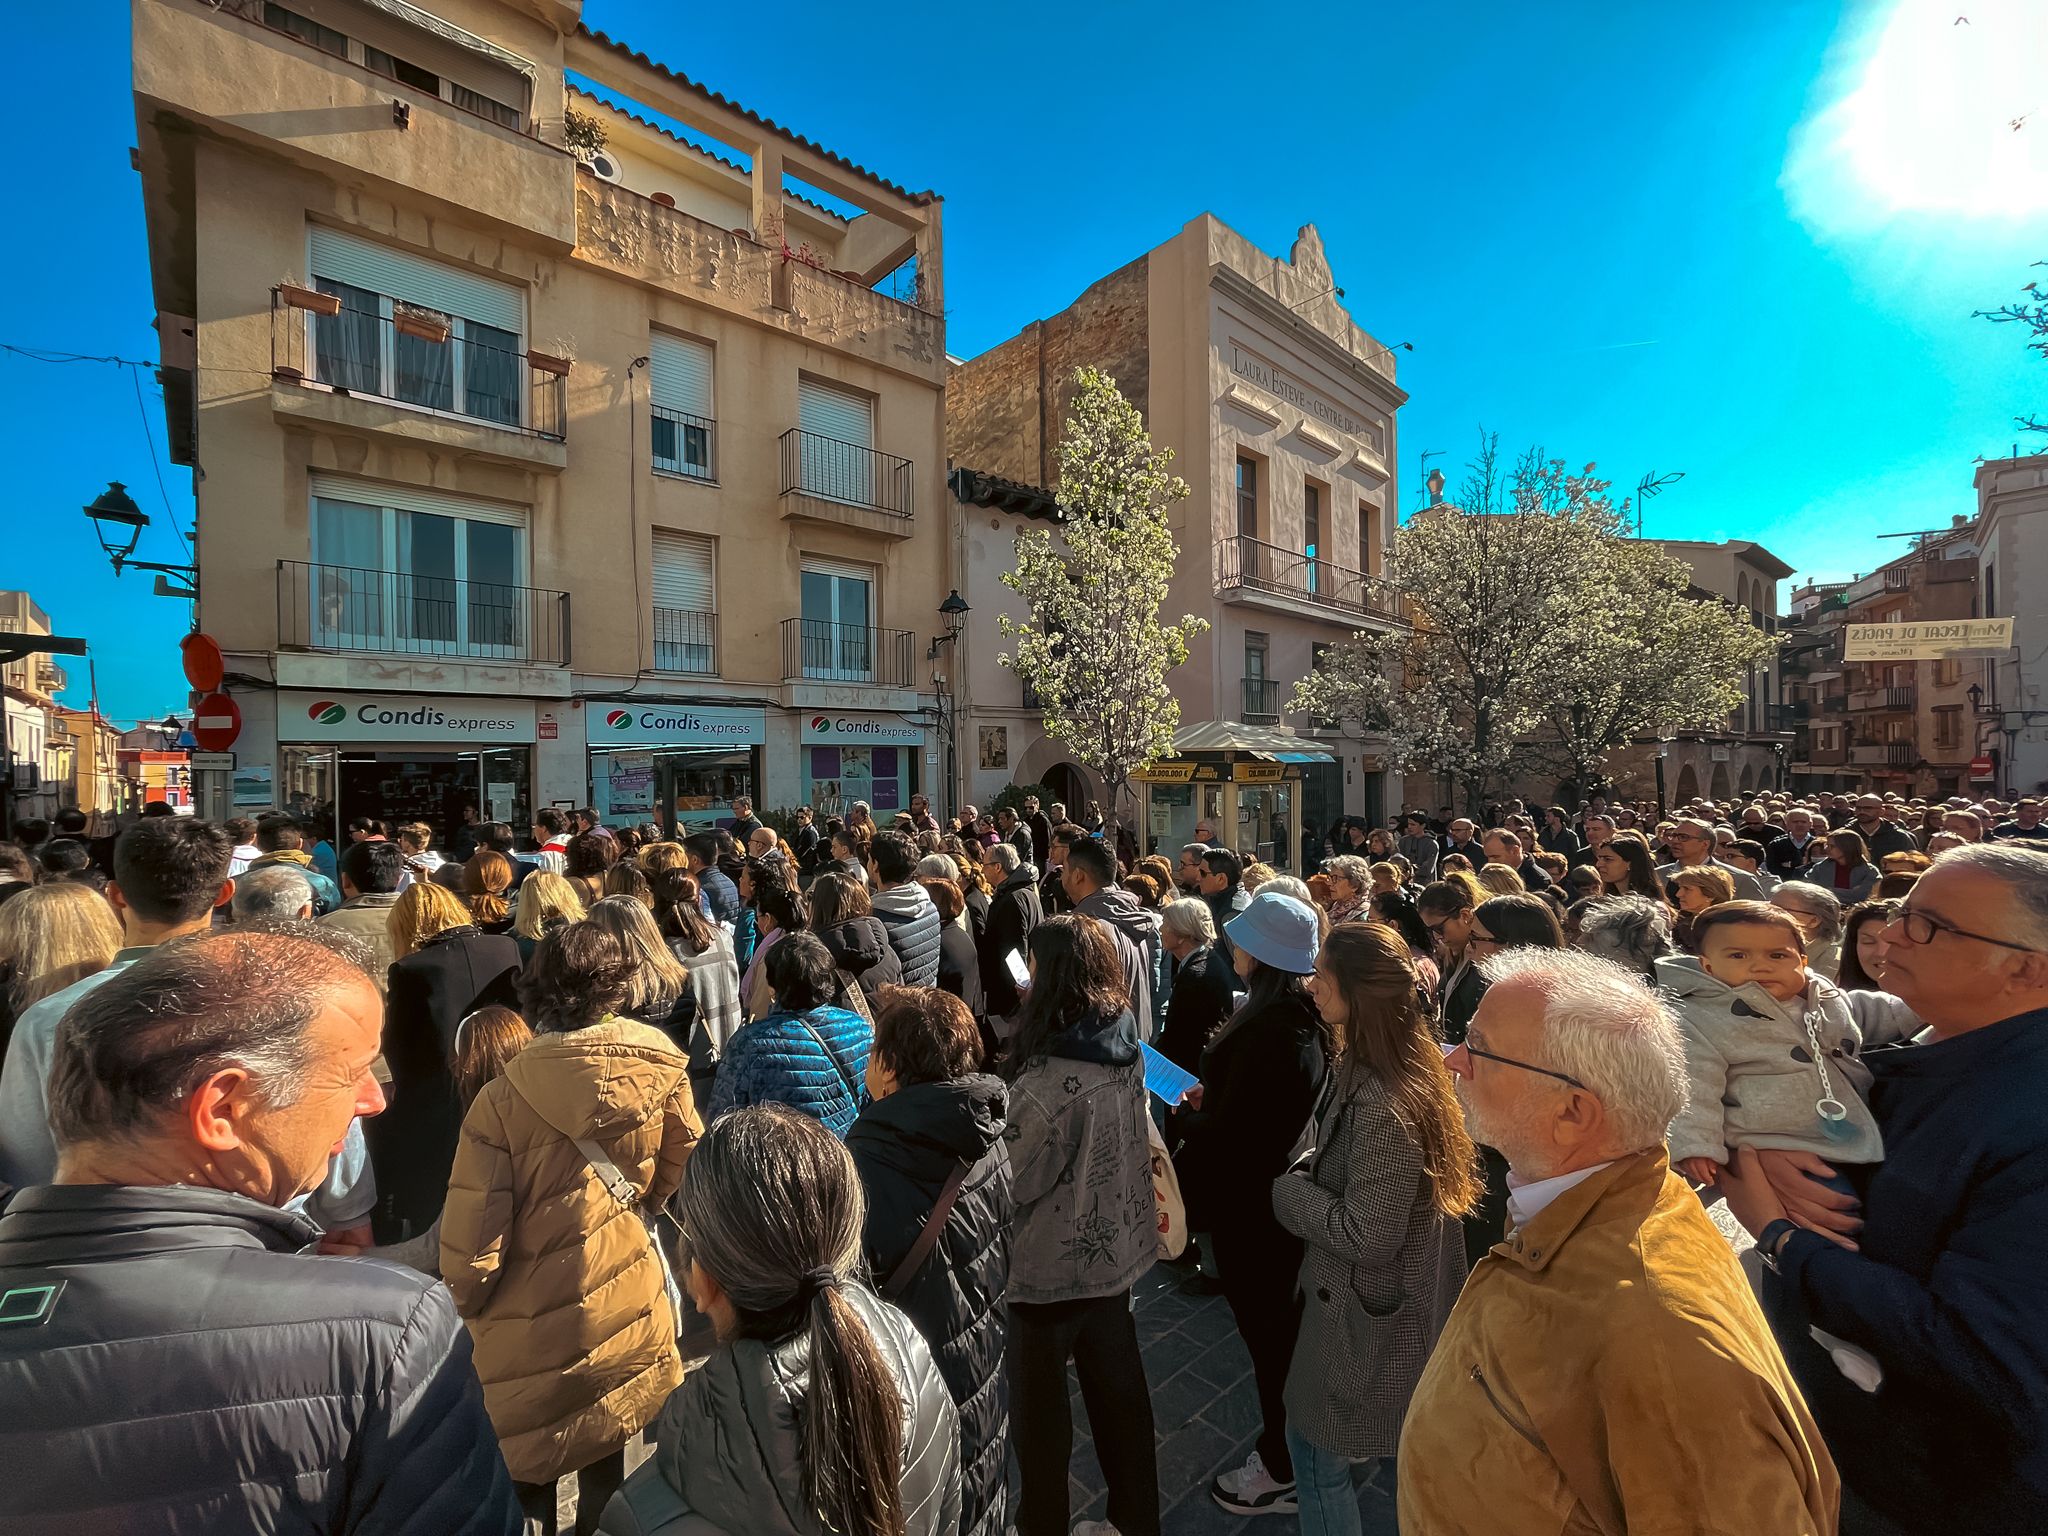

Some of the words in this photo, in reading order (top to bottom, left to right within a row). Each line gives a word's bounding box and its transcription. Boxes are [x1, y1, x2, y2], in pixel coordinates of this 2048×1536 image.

[1233, 347, 1268, 387] LAURA
[1271, 368, 1305, 408] ESTEVE
[1314, 399, 1343, 428] CENTRE
[1344, 418, 1354, 434] DE
[357, 704, 445, 726] Condis
[447, 718, 515, 733] express
[639, 712, 700, 731] Condis
[702, 722, 750, 736] express
[835, 718, 880, 734] Condis
[881, 725, 917, 738] express
